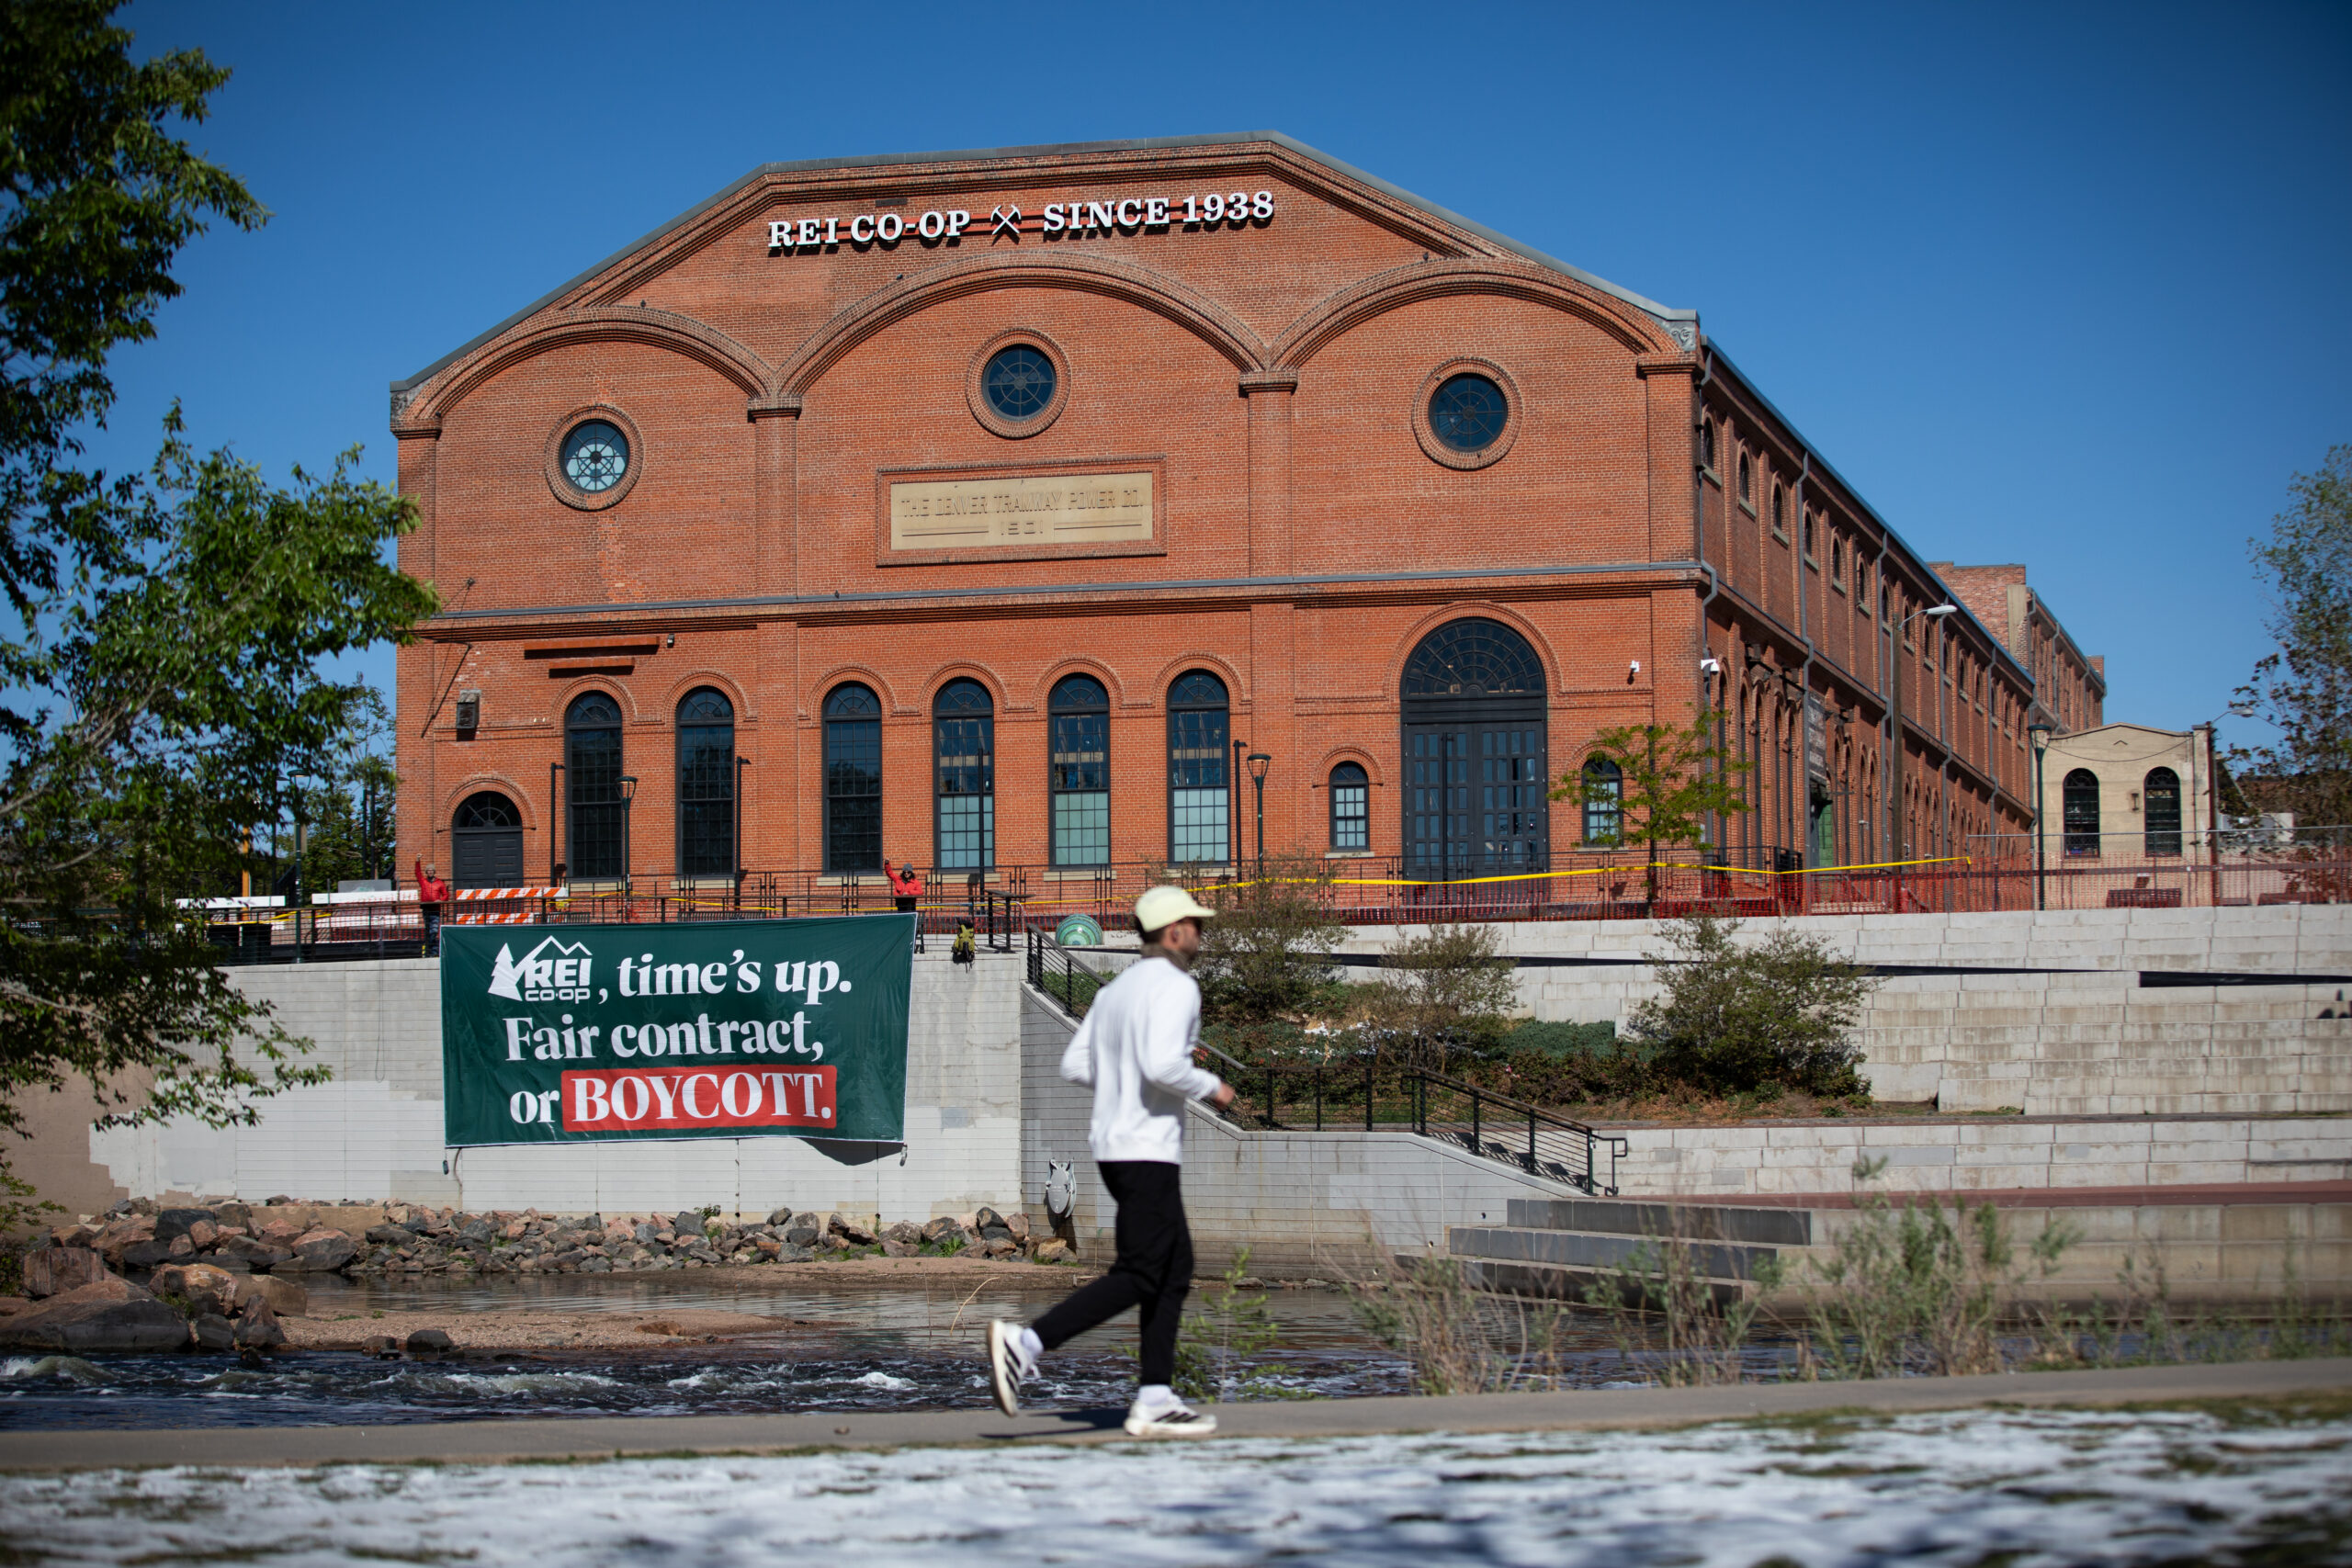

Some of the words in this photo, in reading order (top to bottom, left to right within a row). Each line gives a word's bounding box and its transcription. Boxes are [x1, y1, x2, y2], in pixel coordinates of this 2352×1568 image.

[768, 217, 840, 248] REI
[851, 210, 970, 243] CO-OP
[1044, 197, 1170, 231] SINCE
[1182, 190, 1274, 222] 1938
[900, 498, 930, 517] THE
[935, 496, 988, 515] DENVER
[994, 491, 1062, 513] TRAMWAY
[1069, 491, 1115, 510] POWER
[1123, 490, 1143, 508] CO.
[775, 960, 852, 1006] up.
[503, 1013, 599, 1062] Fair
[610, 1010, 824, 1063] contract,
[509, 1089, 560, 1124] or
[571, 1072, 831, 1122] BOYCOTT.
